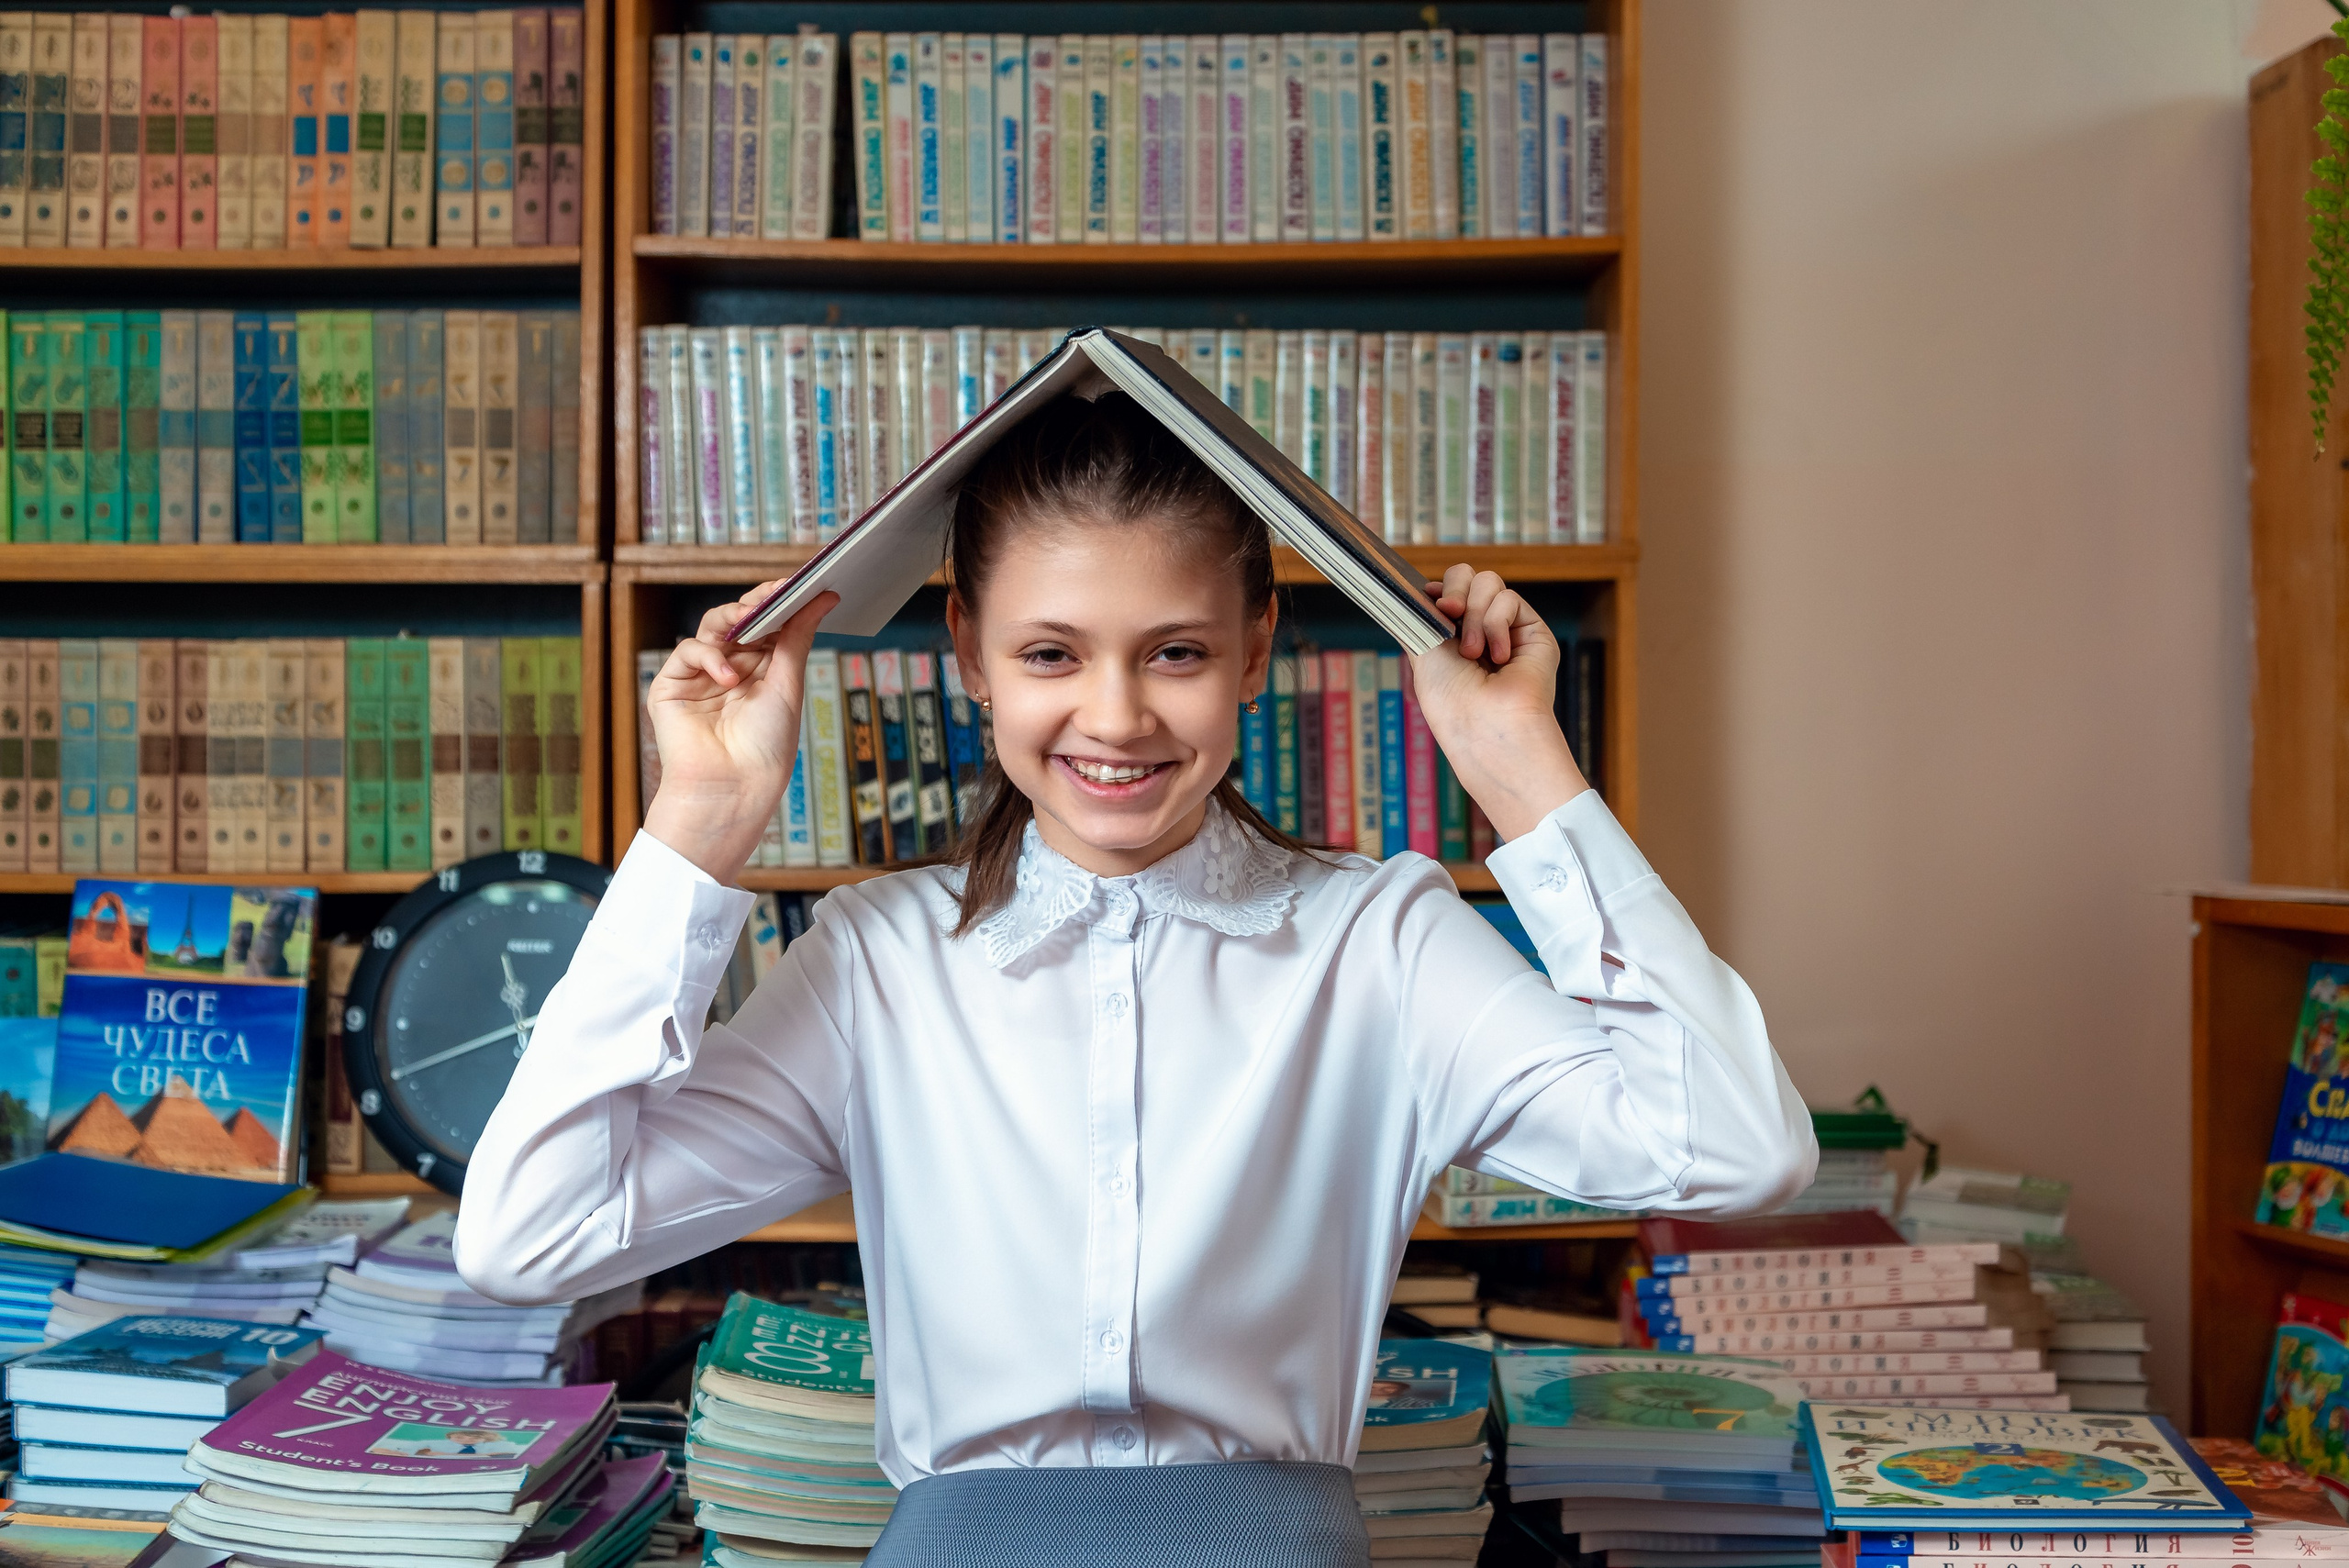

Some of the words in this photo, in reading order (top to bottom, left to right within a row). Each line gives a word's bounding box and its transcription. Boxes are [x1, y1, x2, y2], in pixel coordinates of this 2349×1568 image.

[849, 653, 864, 687] 1
[875, 652, 903, 695] 2
[517, 850, 548, 874] 12
[438, 869, 460, 893] 11
[372, 926, 398, 951] 10
[145, 987, 219, 1026] ВСЕ
[345, 1007, 366, 1033] 9
[104, 1024, 252, 1065] ЧУДЕСА
[112, 1061, 231, 1101] СВЕТА
[359, 1088, 383, 1117] 8
[415, 1151, 438, 1179] 7
[241, 1328, 301, 1346] 10
[743, 1340, 833, 1374] 8
[740, 1368, 864, 1392] Student's
[318, 1373, 511, 1416] ENJOY
[273, 1399, 373, 1440] 7
[300, 1386, 557, 1432] ENGLISH
[1691, 1408, 1746, 1430] 7
[1913, 1412, 2058, 1429] МИР
[1836, 1419, 1867, 1431] И
[1887, 1420, 2144, 1440] ЧЕЛОВЕК
[237, 1440, 363, 1469] Student's
[370, 1462, 440, 1473] Book
[1983, 1444, 2017, 1455] 2
[1947, 1532, 2184, 1554] БИОЛОГИЯ
[2232, 1534, 2255, 1556] 10
